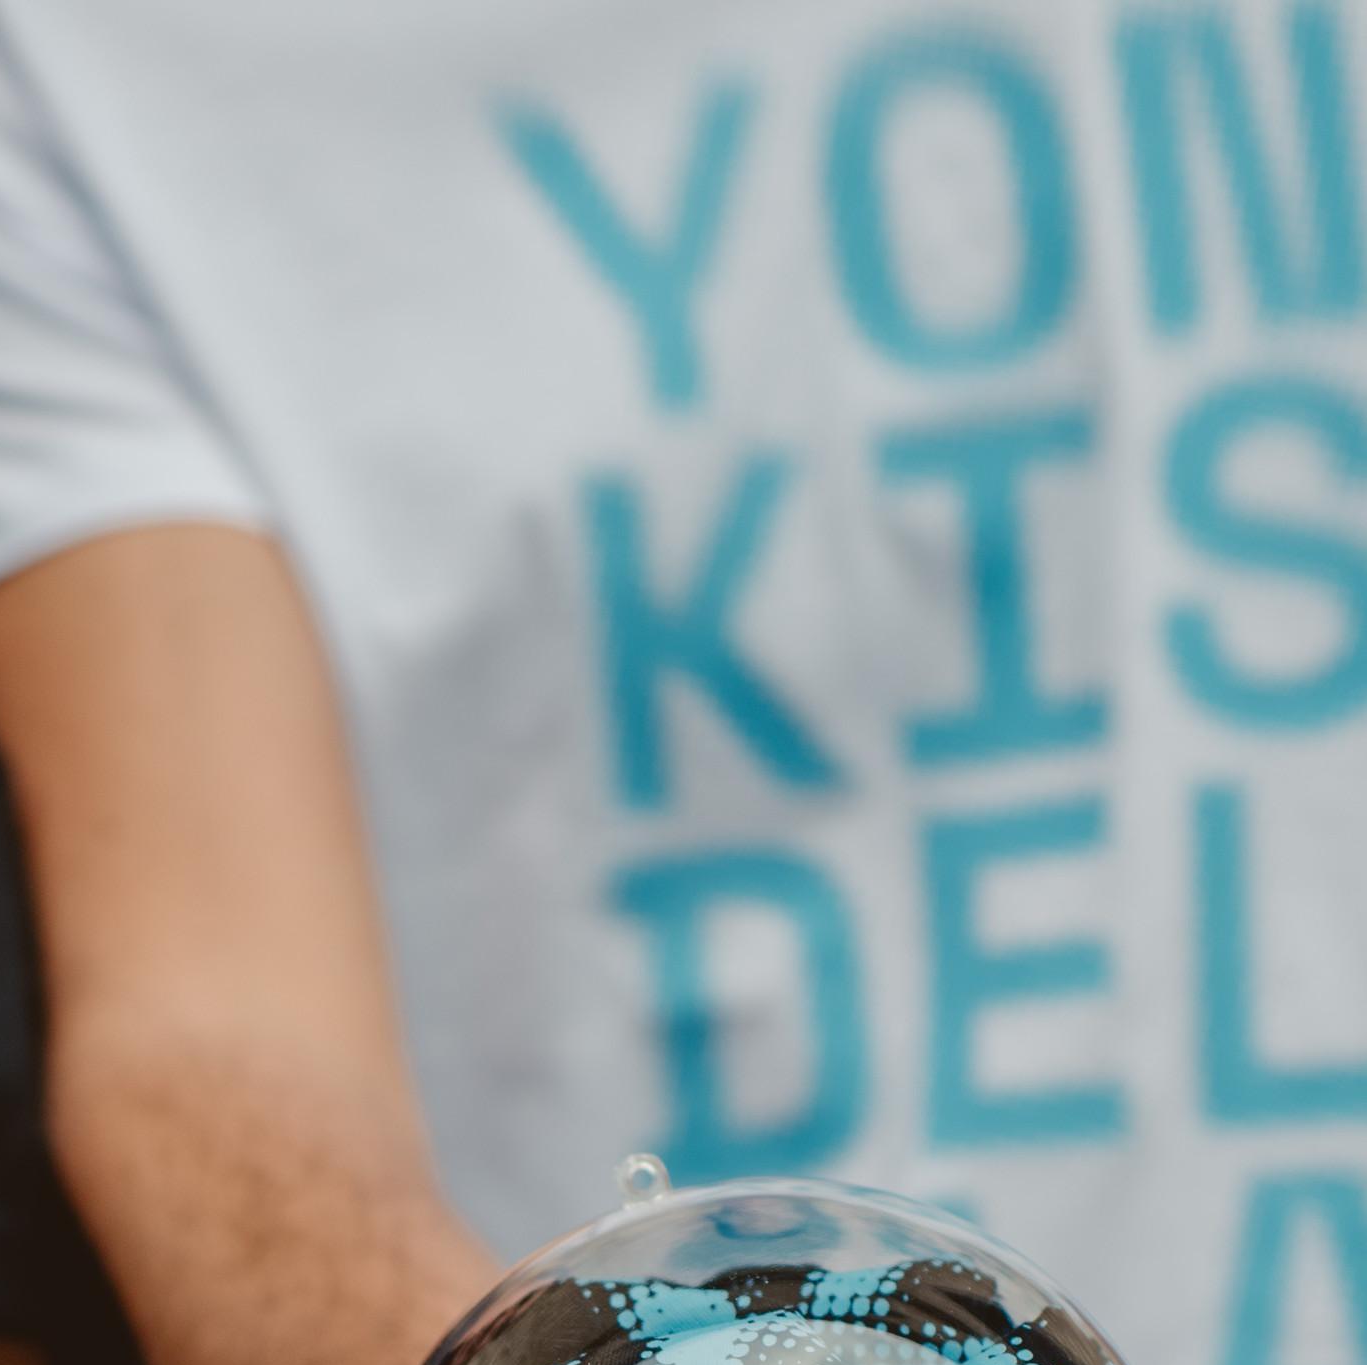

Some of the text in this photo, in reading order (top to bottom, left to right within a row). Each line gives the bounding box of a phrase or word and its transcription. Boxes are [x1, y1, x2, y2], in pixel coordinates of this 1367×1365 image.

[488, 2, 1367, 412] YON
[578, 372, 1367, 802] KIS
[605, 772, 1367, 1185] DEL
